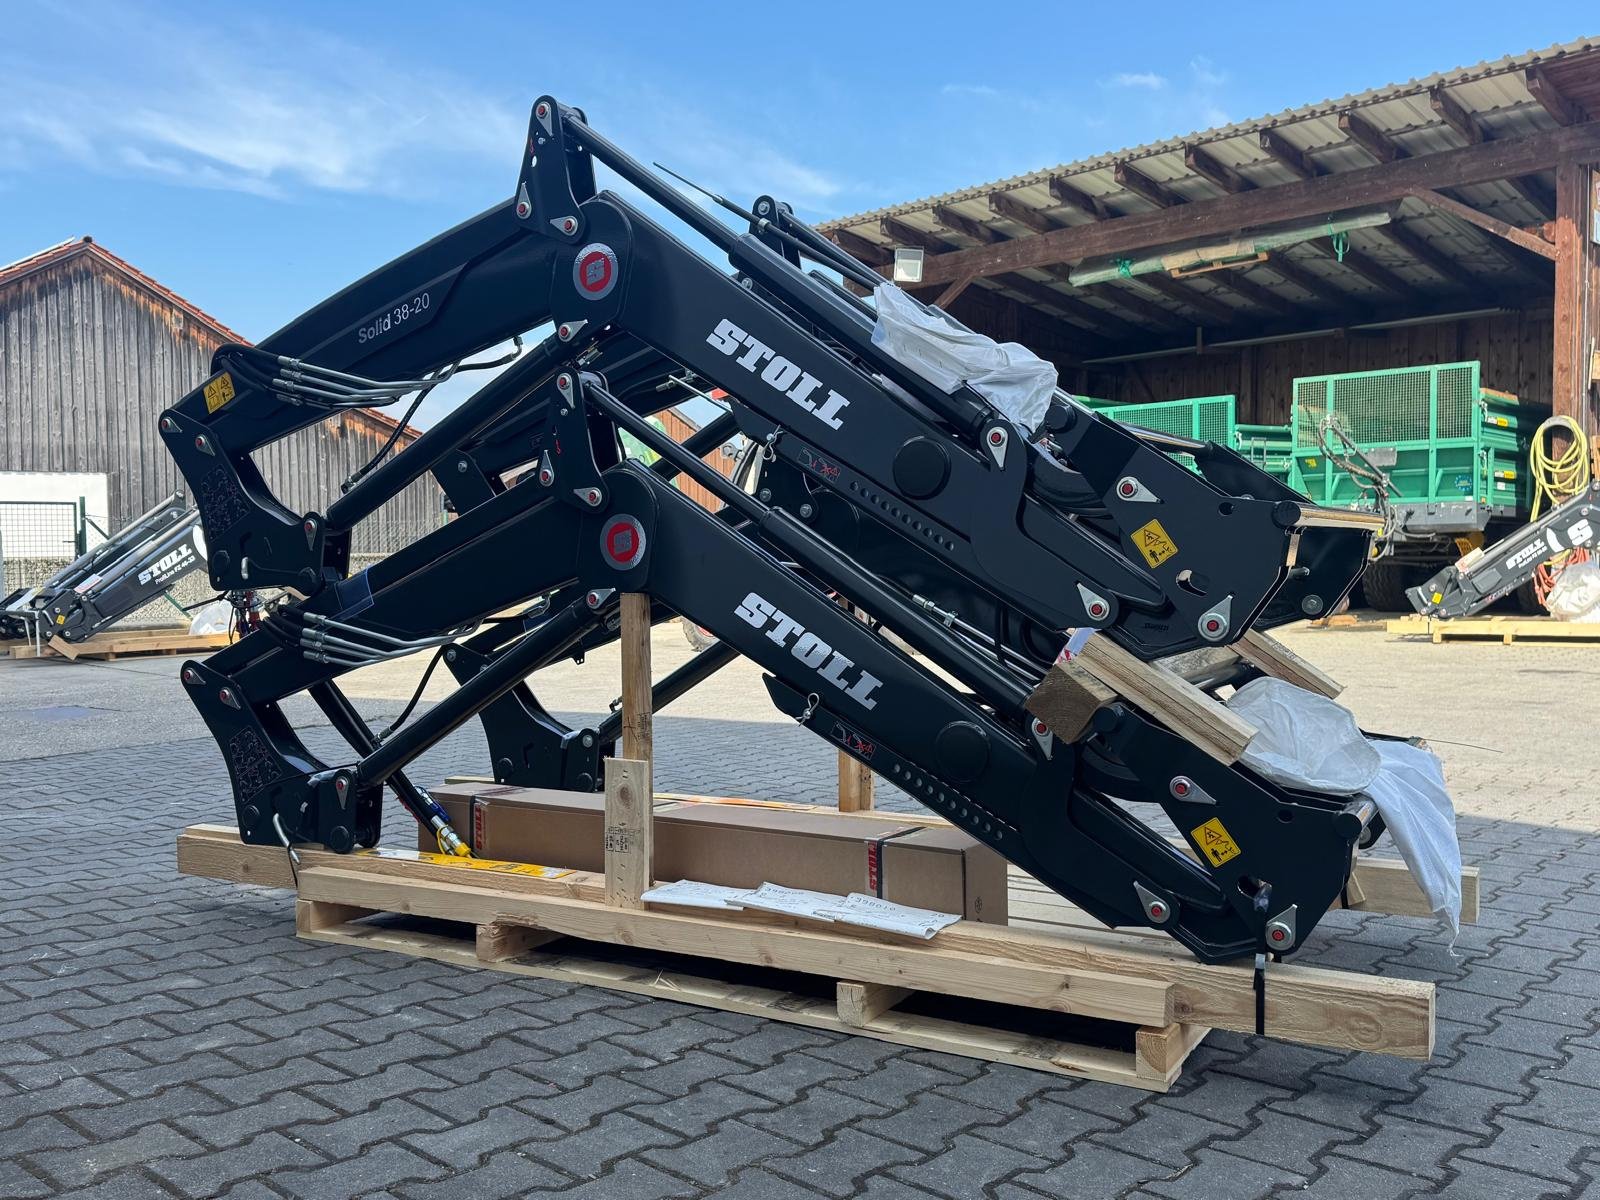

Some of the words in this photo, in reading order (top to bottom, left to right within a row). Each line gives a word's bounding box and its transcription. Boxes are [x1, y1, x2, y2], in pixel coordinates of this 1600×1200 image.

[358, 313, 392, 344] Solid
[393, 292, 430, 325] 38-20
[705, 318, 851, 431] STOLL
[137, 543, 193, 586] STOLL
[733, 592, 884, 711] STOLL
